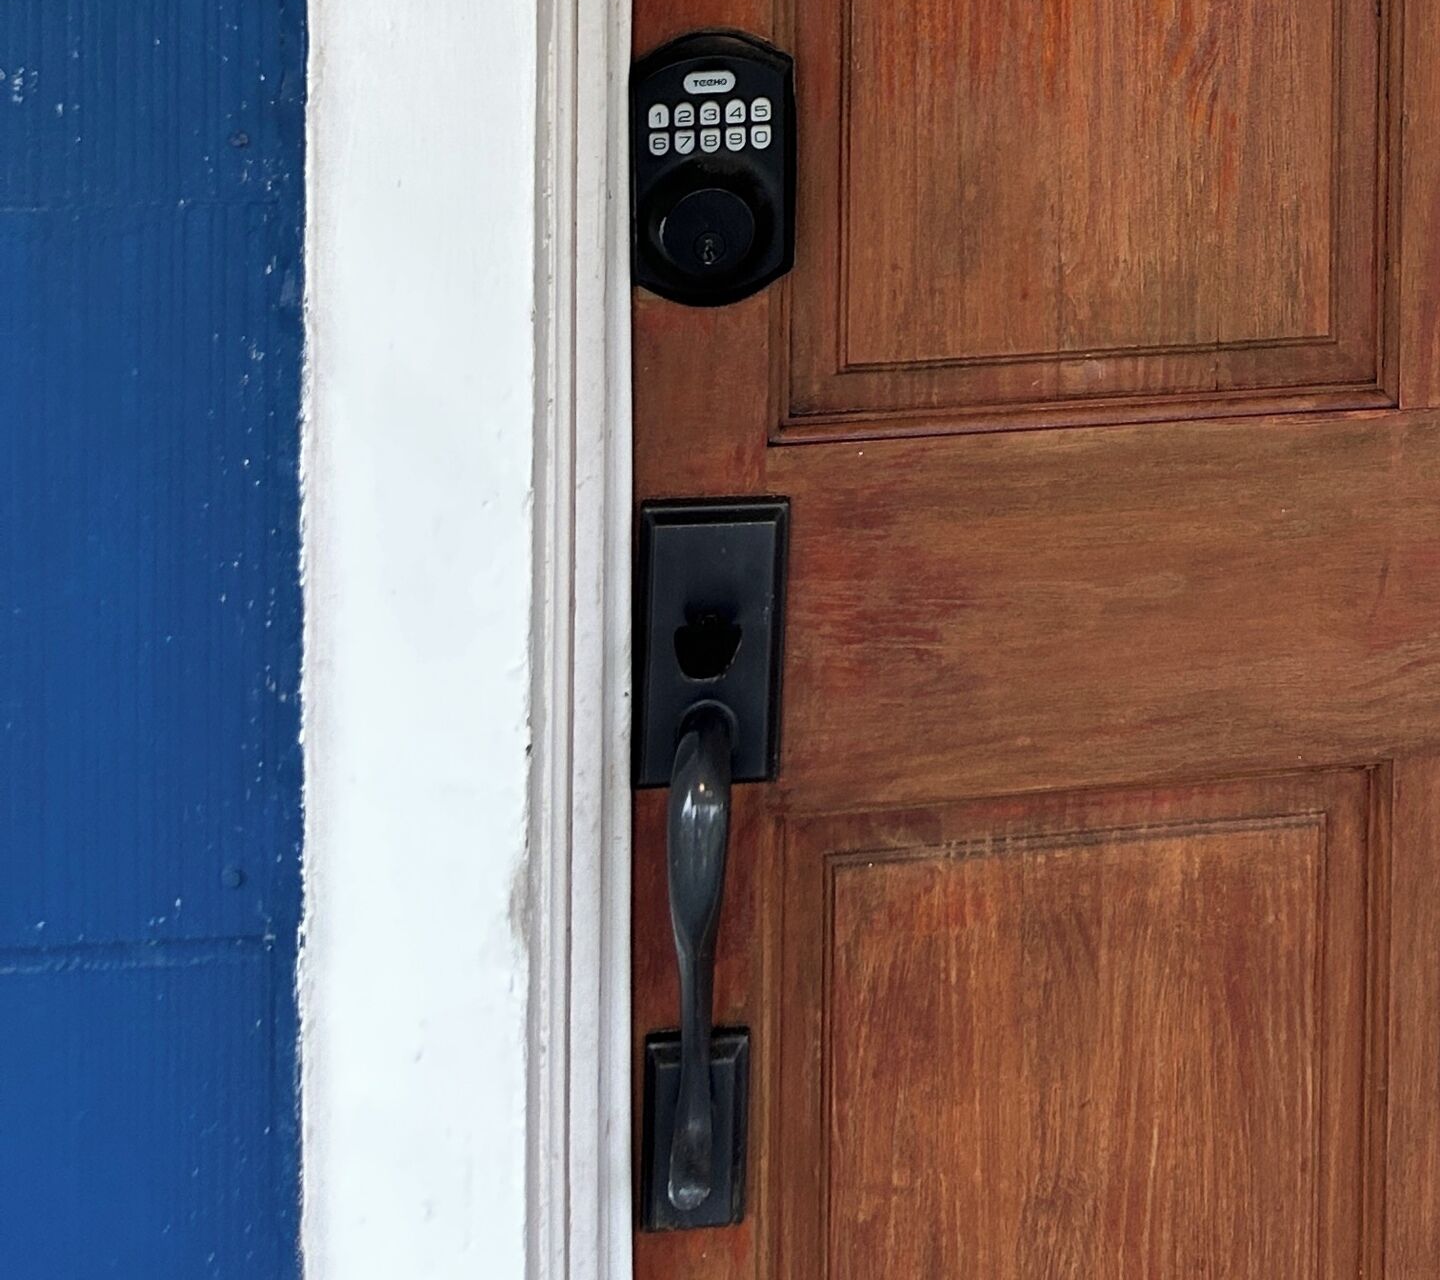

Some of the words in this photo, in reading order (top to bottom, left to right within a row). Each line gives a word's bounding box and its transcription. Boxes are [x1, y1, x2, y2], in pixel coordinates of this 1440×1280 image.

[678, 110, 692, 123] 2
[703, 108, 717, 121] 3
[729, 106, 742, 119] 4
[754, 104, 768, 117] 5
[653, 137, 666, 150] 6
[679, 135, 692, 148] 7
[704, 134, 717, 147] 8
[729, 132, 742, 145] 9
[754, 130, 768, 143] 0
